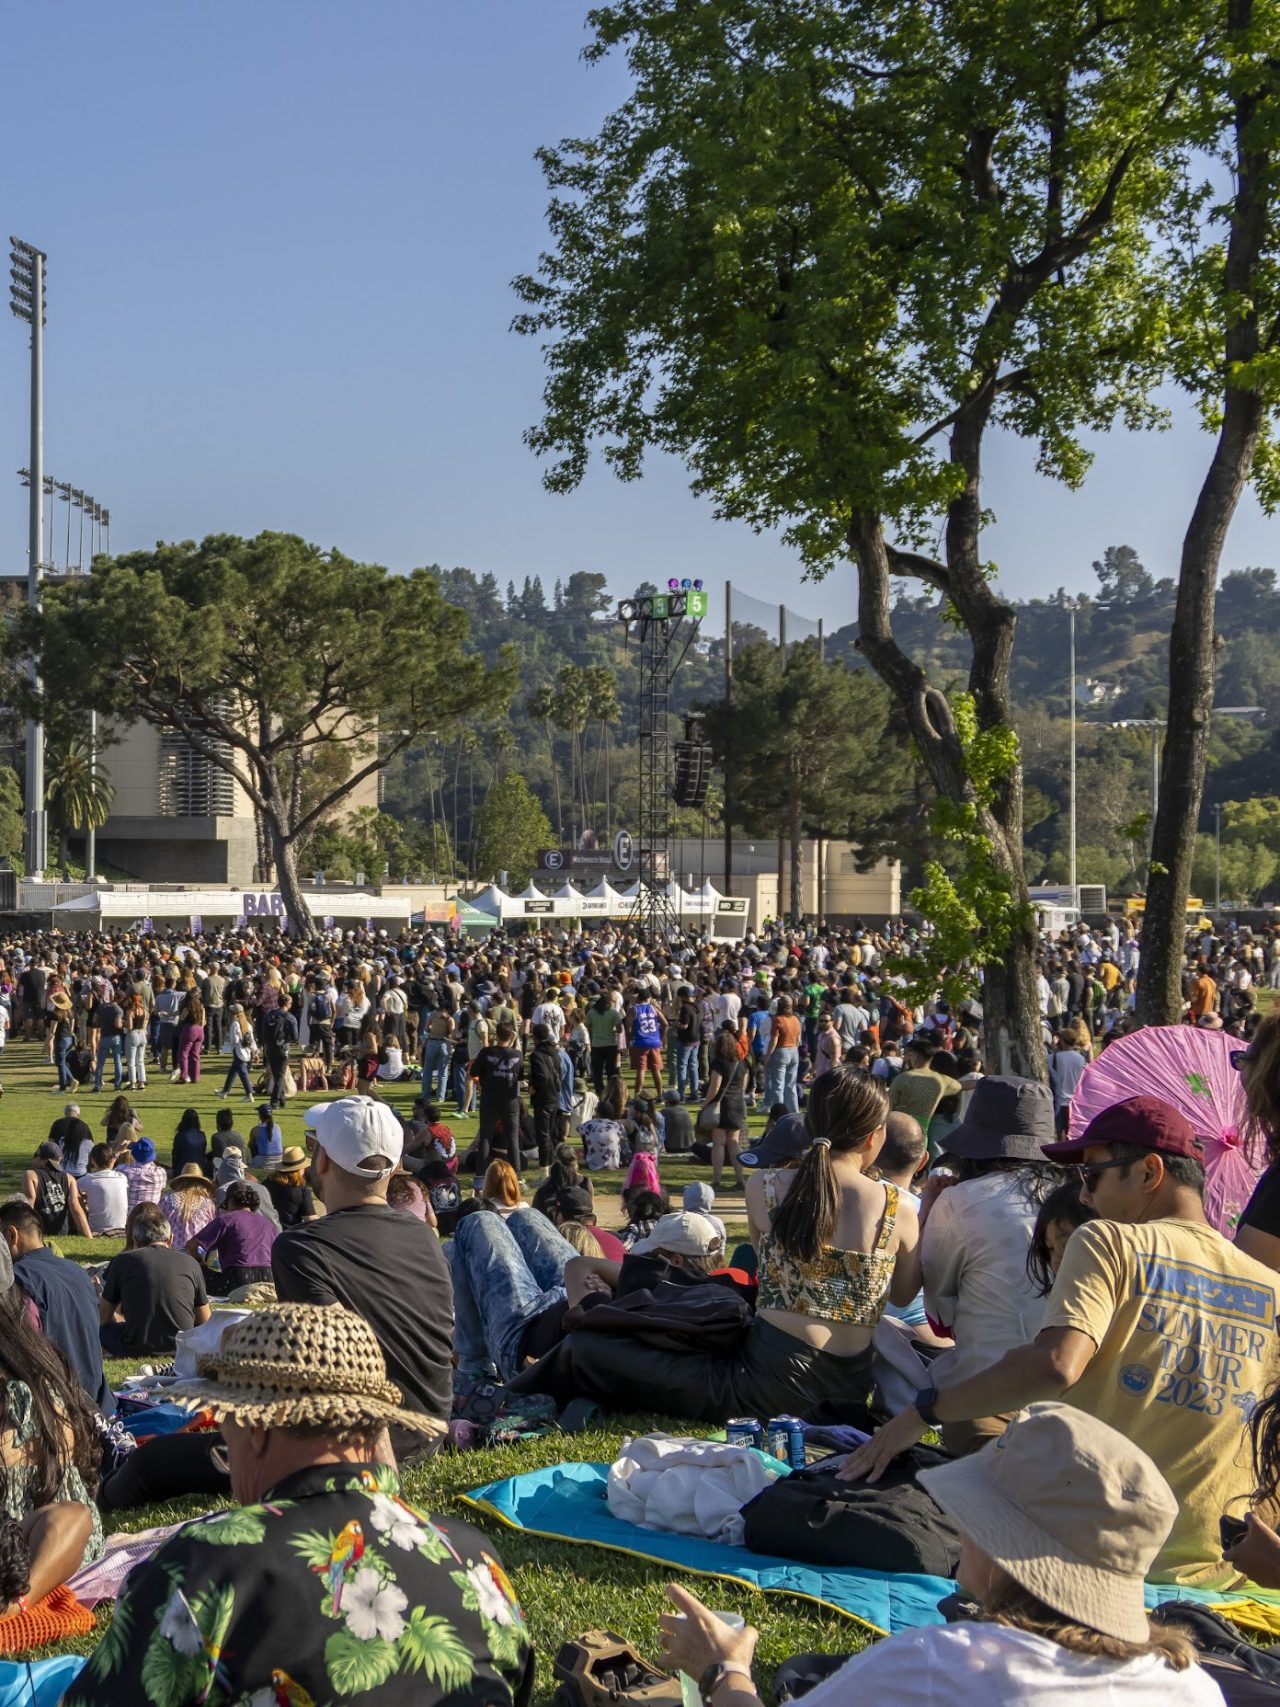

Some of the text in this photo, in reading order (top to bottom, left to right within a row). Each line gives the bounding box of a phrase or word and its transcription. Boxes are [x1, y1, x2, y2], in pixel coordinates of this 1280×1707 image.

[692, 596, 702, 612] 5
[243, 893, 286, 916] BAR
[1136, 1302, 1266, 1363] SUMMER
[1158, 1338, 1243, 1388] TOUR
[1155, 1373, 1226, 1416] 2023
